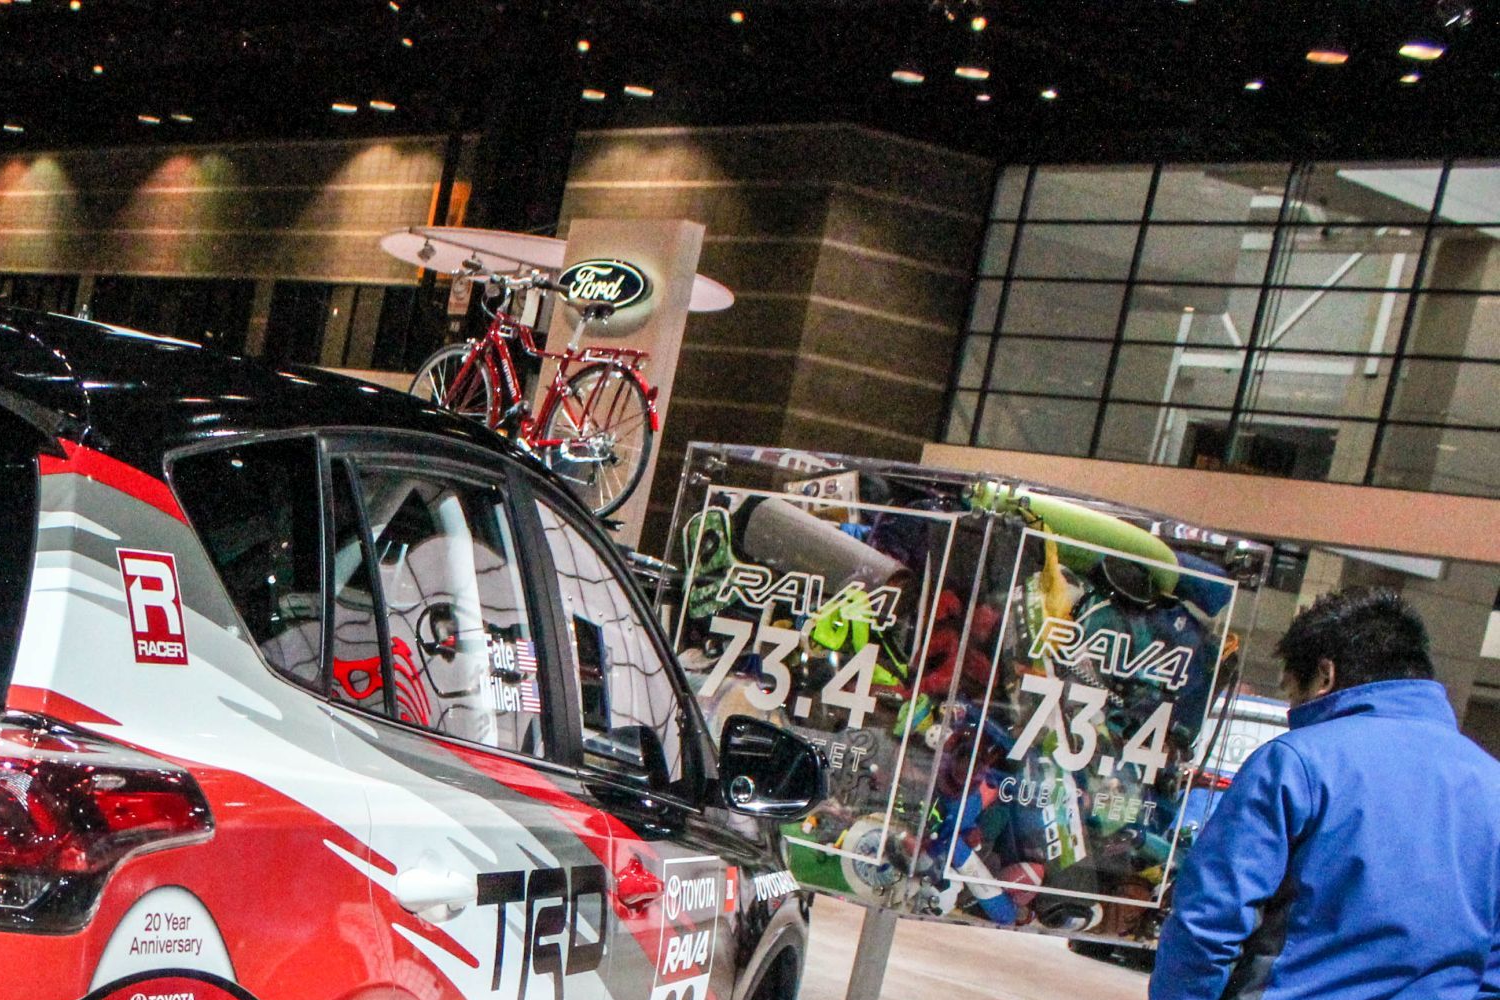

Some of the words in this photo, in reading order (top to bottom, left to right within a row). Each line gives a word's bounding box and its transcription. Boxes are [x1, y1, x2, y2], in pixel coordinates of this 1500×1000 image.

[569, 265, 626, 301] Ford
[716, 562, 902, 631] RAV4
[136, 639, 185, 658] RACER
[1028, 617, 1193, 690] RAV4
[698, 616, 877, 729] 73.4
[1006, 673, 1168, 785] 73.4
[998, 776, 1083, 809] CUBI
[1092, 792, 1157, 826] FEET
[681, 876, 716, 913] TOYOTA
[144, 912, 162, 932] 20
[164, 912, 191, 931] Year
[129, 936, 203, 956] Anniversary
[662, 930, 711, 975] RAV4
